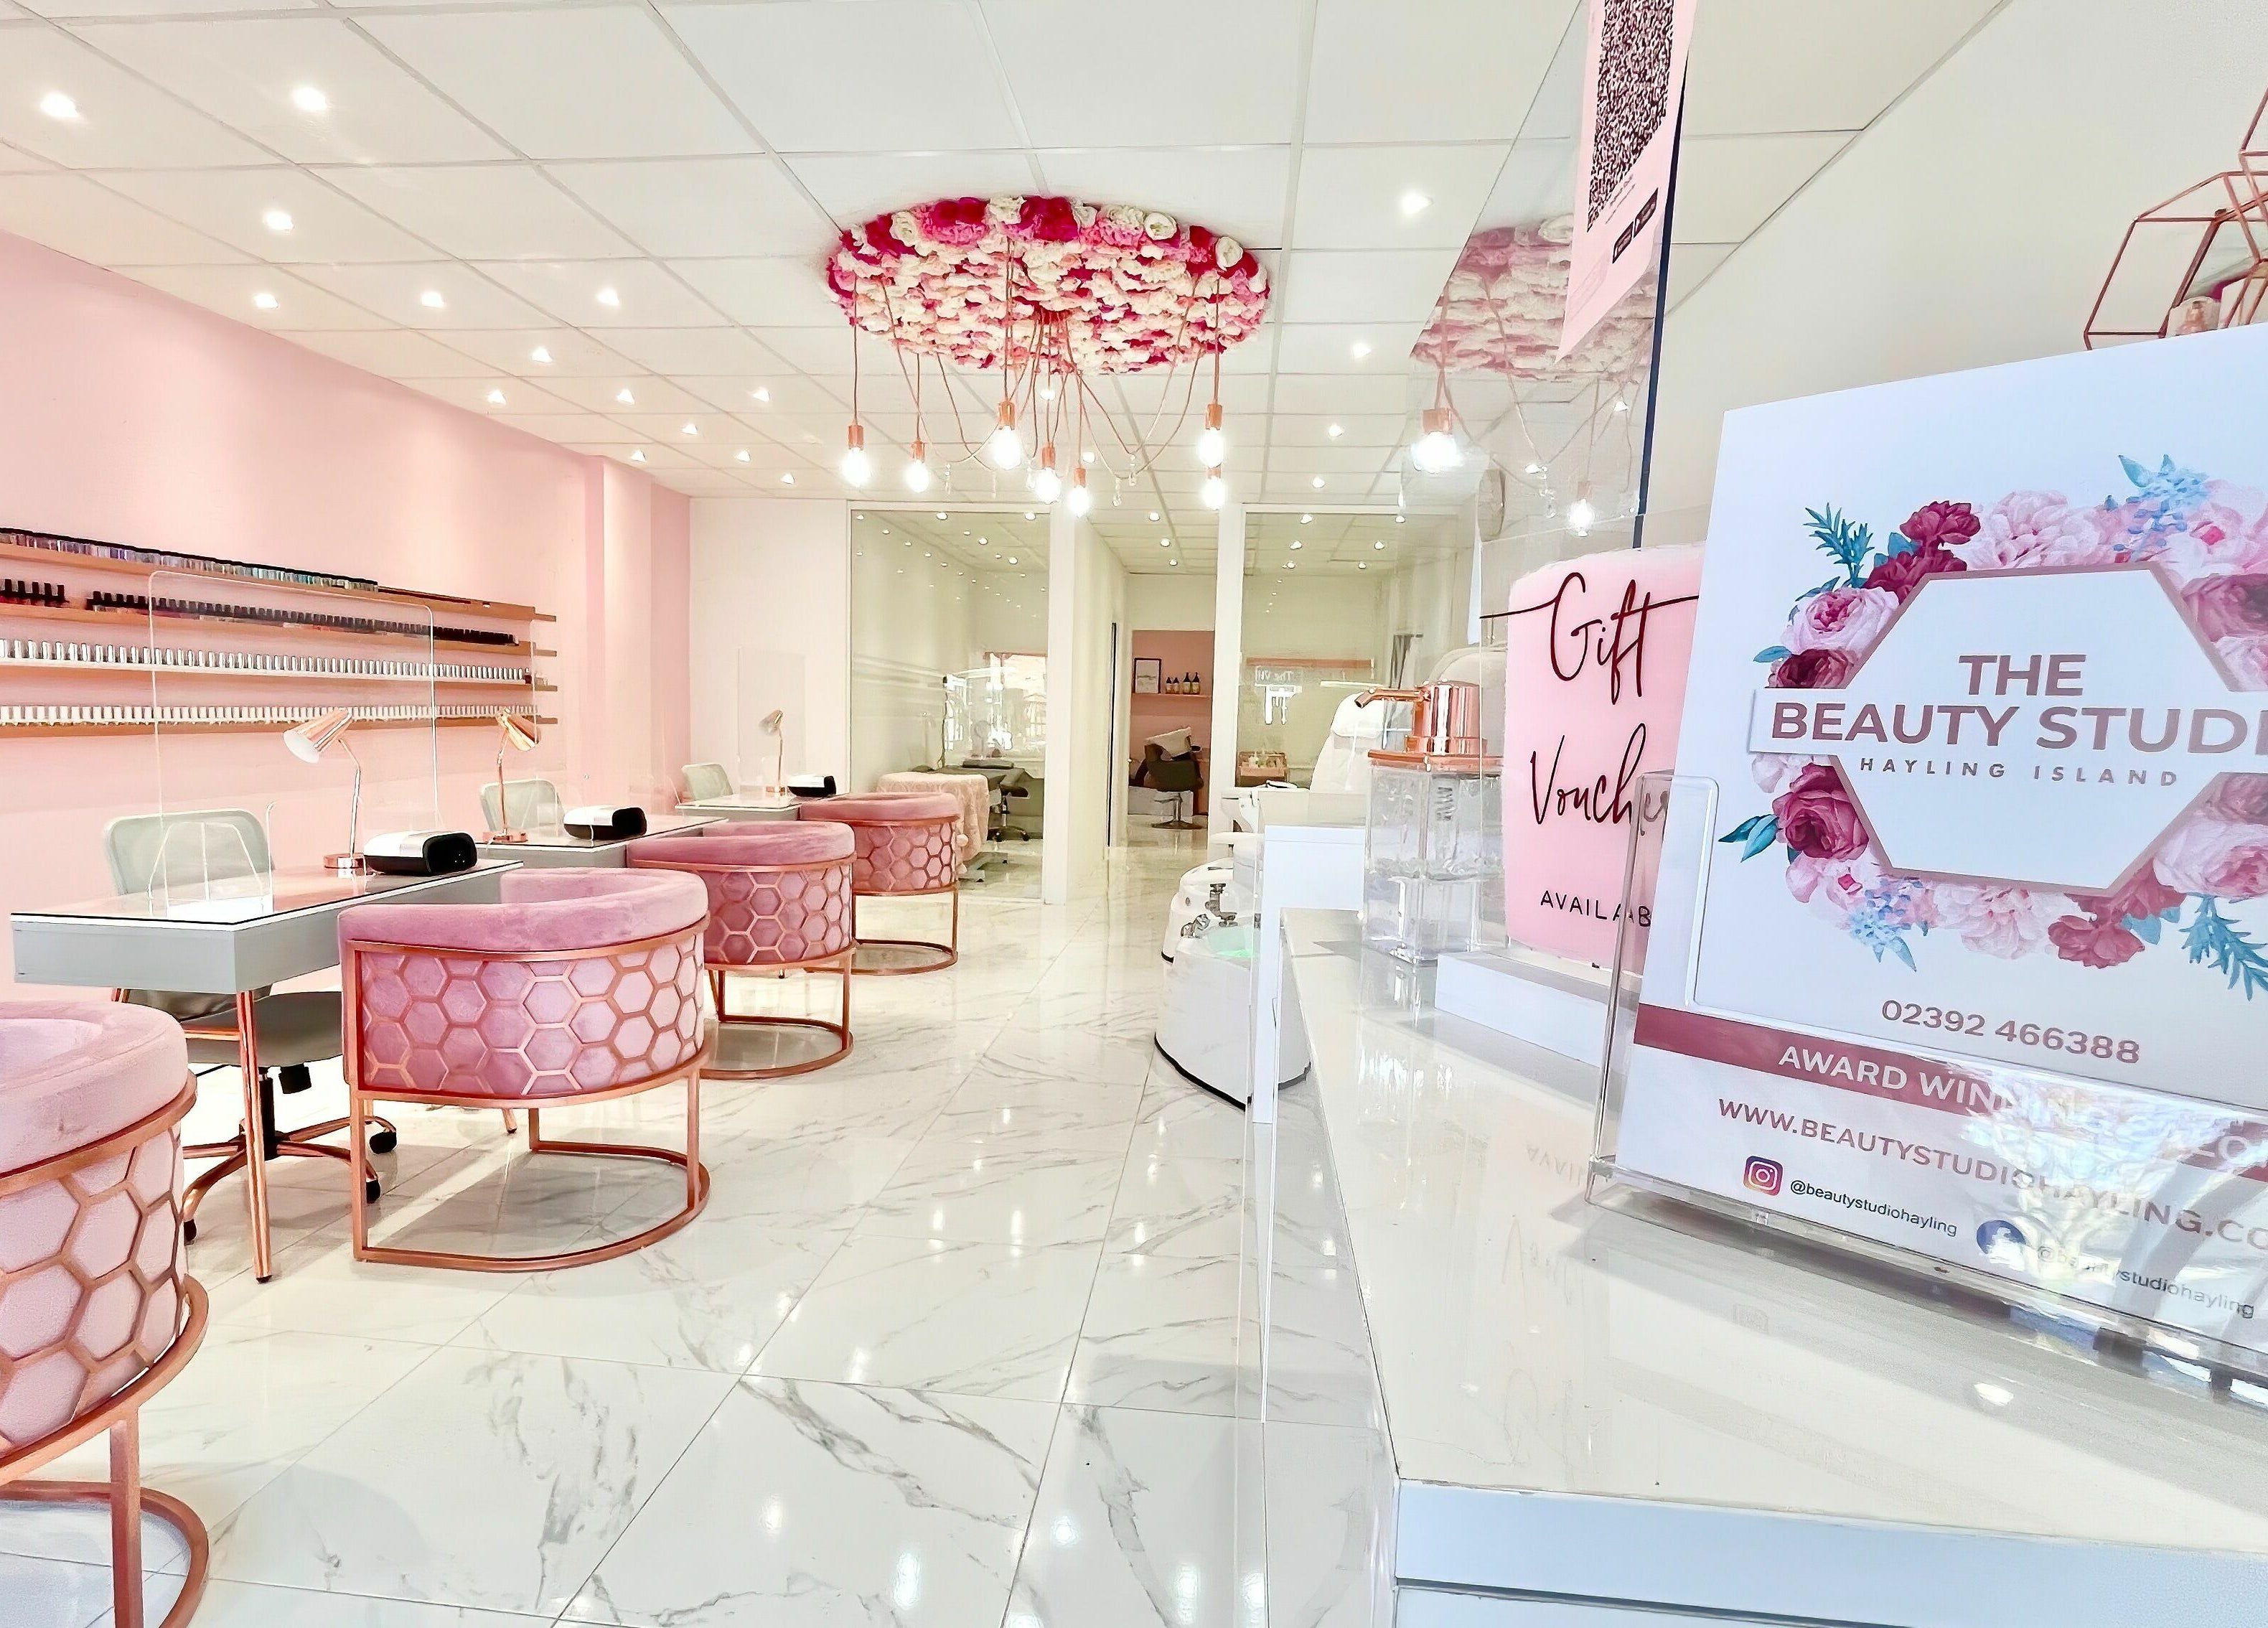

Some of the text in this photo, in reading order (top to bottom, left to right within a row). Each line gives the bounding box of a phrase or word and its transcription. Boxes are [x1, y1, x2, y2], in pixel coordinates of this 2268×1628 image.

[1958, 654, 2086, 696] THE
[1771, 703, 2020, 747] BEAUTY
[1860, 757, 2178, 787] HAYLING ISLAND
[1881, 999, 2140, 1064] 02392 466388
[1779, 1046, 1907, 1090] AWARD
[1790, 1179, 1957, 1238] @beautystudiohayling
